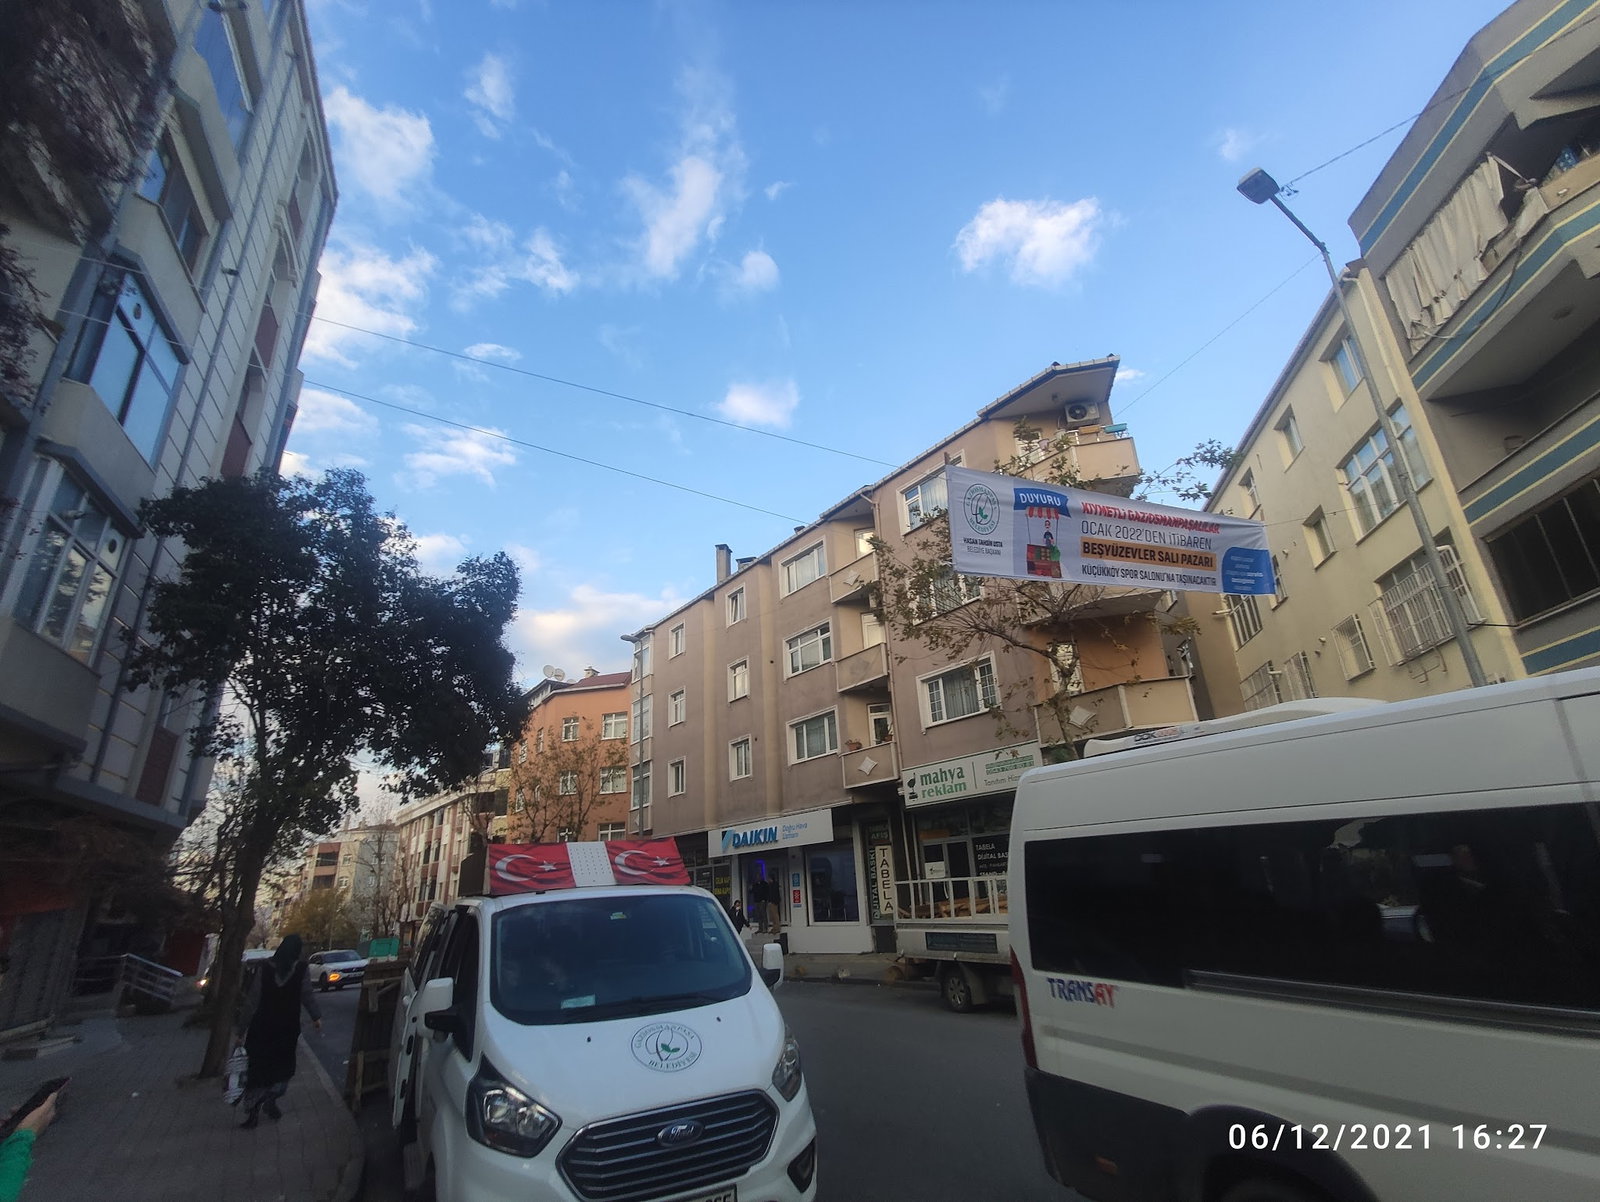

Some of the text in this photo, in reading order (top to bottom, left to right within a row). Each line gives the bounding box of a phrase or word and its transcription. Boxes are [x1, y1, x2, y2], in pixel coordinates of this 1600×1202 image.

[1019, 493, 1062, 507] DUYURU
[1081, 502, 1125, 520] KIYMETLİ
[1081, 520, 1113, 538] OCAK
[1115, 525, 1166, 544] 2022'DEN
[1082, 541, 1214, 567] BEŞYÜZEVLER SALI PAZARI
[1081, 564, 1119, 578] KÜÇÜKKÖY
[1121, 568, 1139, 580] SPOR
[1139, 570, 1175, 582] SALONU'NA
[1176, 574, 1217, 586] TAŞINACAKTIR
[920, 766, 965, 786] mahya
[921, 782, 967, 799] reklam
[732, 826, 778, 847] DAIKIN
[879, 848, 893, 911] TABELA
[1047, 977, 1115, 1009] TRANSAY
